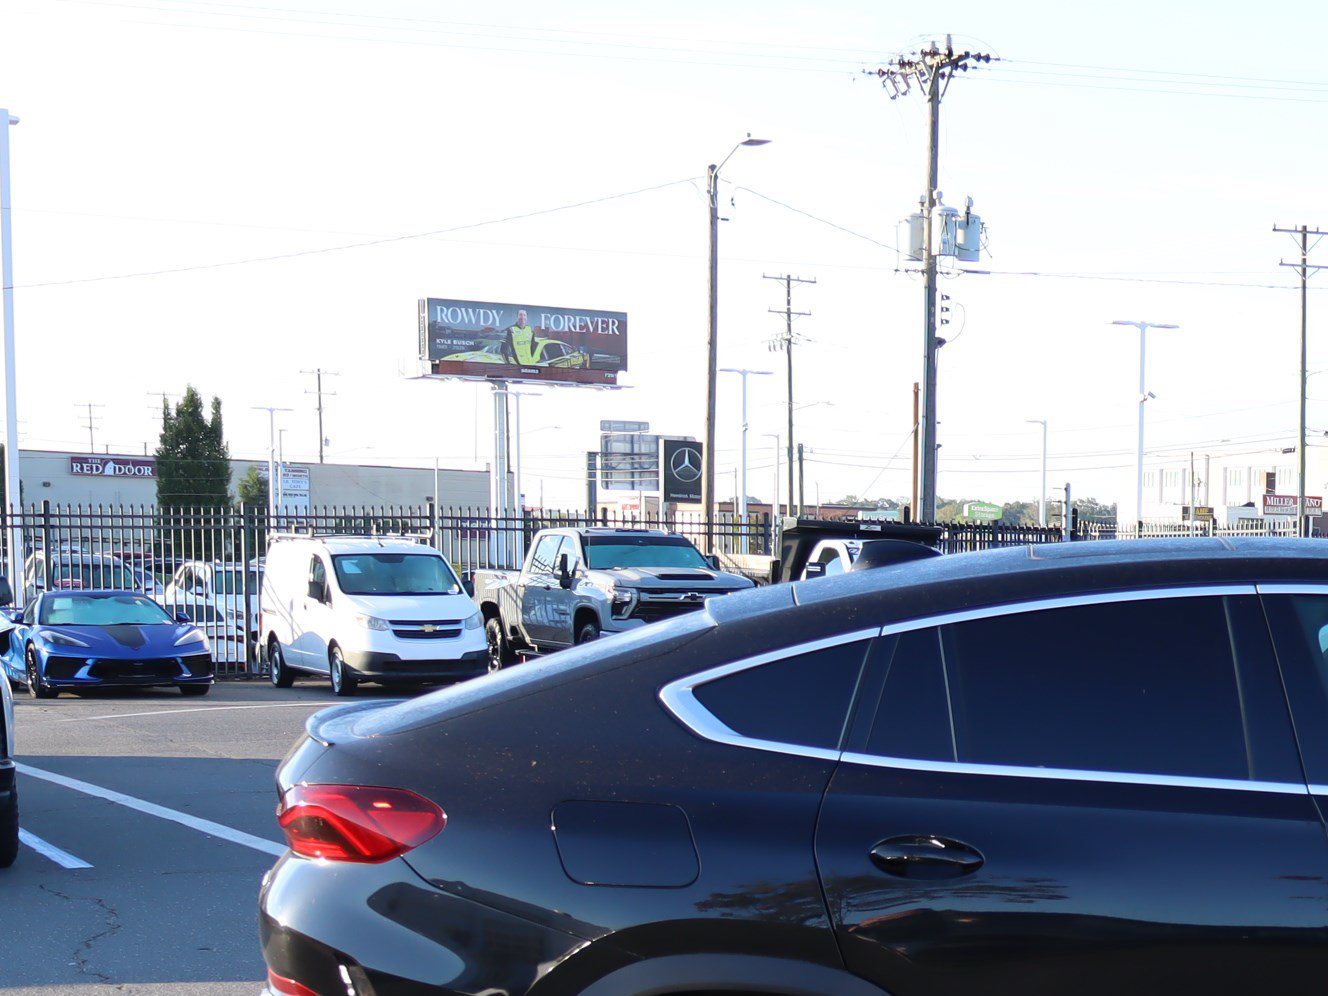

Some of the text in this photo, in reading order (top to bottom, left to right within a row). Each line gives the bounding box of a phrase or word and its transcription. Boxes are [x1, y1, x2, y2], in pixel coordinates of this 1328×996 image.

[436, 305, 621, 336] ROWDY FOREVER
[72, 462, 153, 476] RED DOOR
[1266, 496, 1294, 506] MILLER
